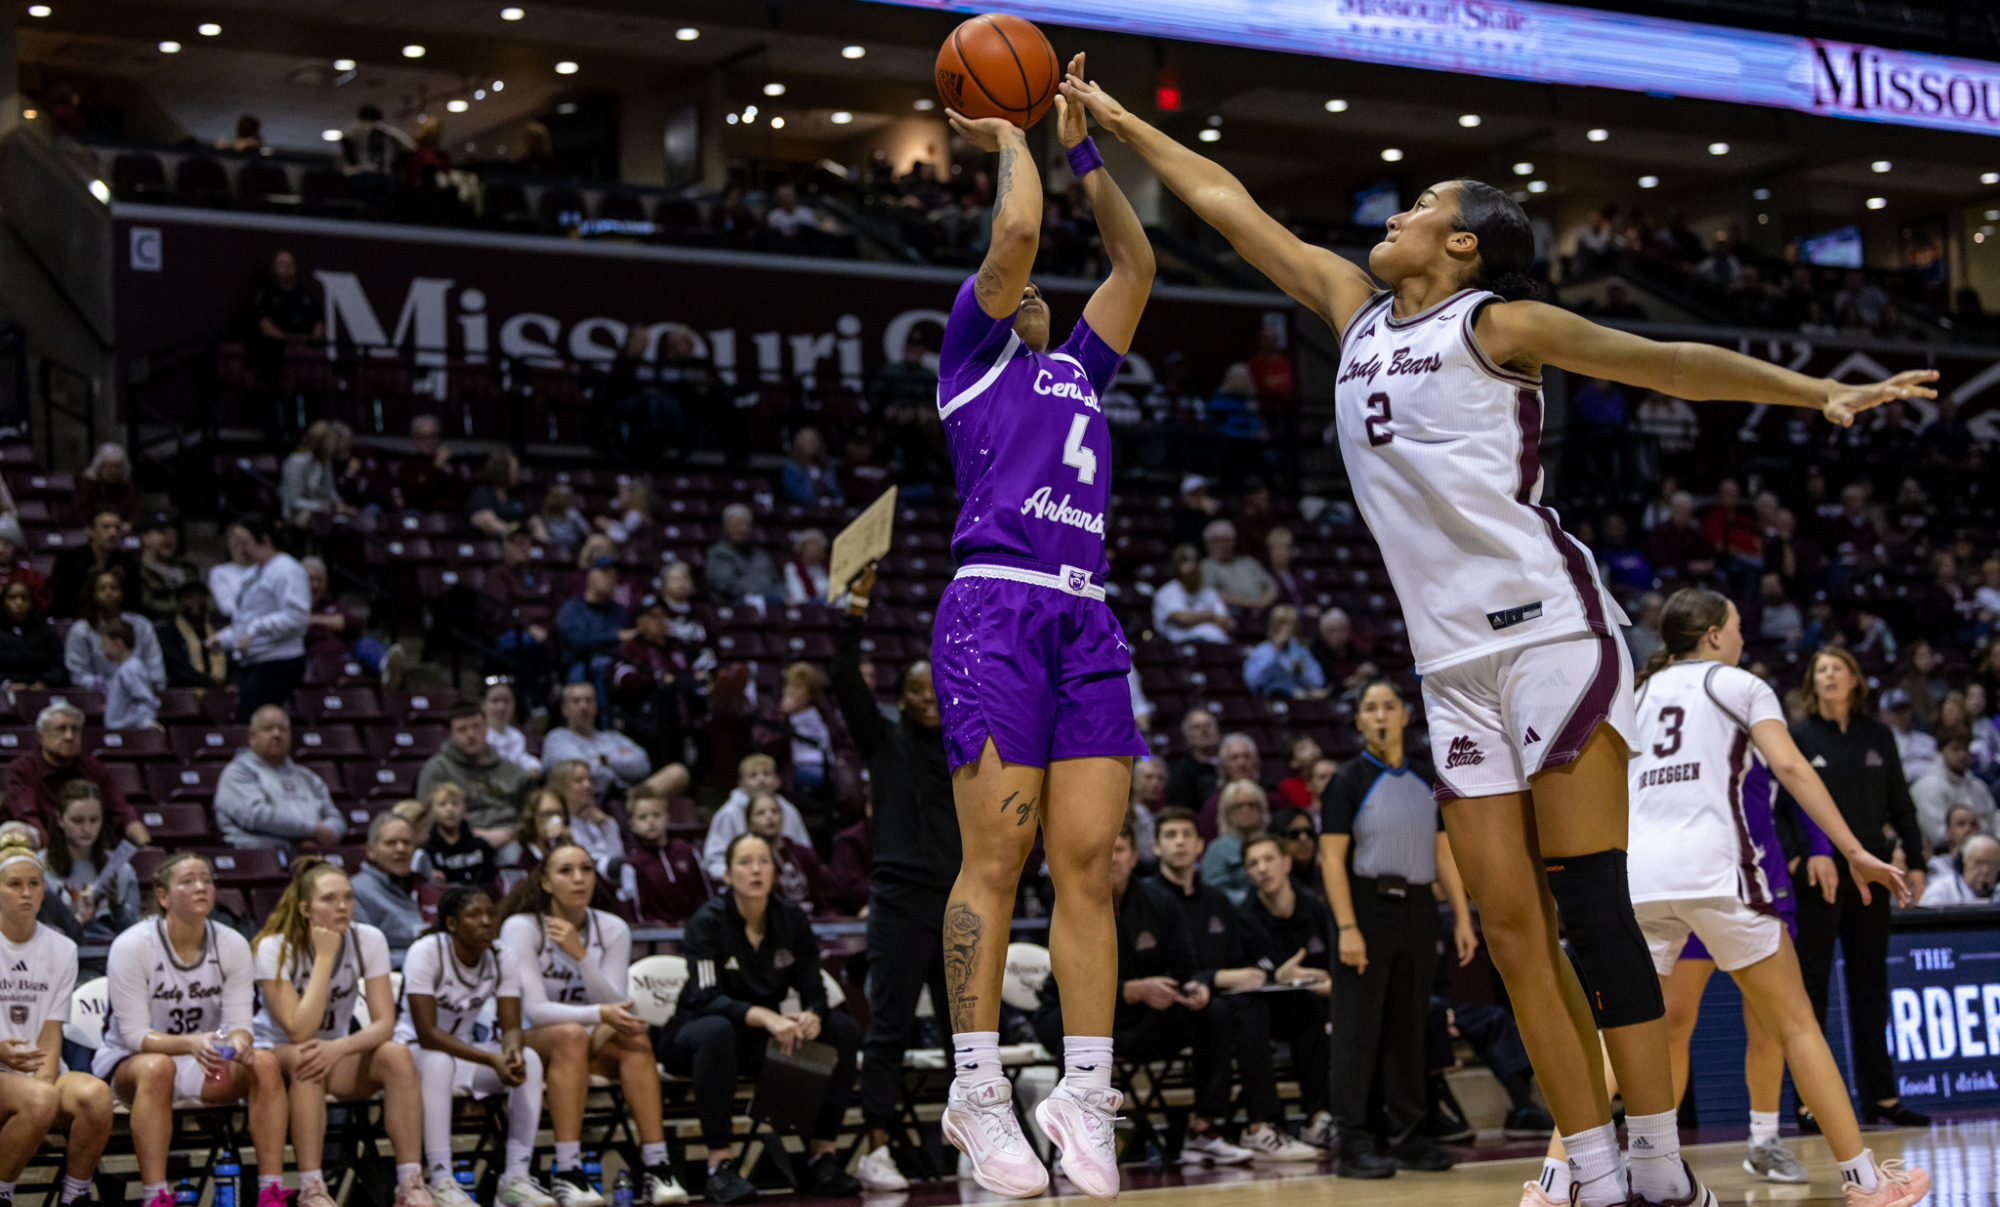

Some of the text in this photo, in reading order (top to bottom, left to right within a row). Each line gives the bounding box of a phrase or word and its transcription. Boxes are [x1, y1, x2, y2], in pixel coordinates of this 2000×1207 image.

[136, 235, 156, 264] C
[1338, 346, 1442, 387] Lady Bears
[1365, 391, 1394, 447] 2
[1062, 412, 1097, 485] 4
[1448, 735, 1477, 755] Mo
[1653, 706, 1685, 758] 3
[1445, 749, 1485, 769] State
[1909, 947, 1955, 970] THE
[168, 1008, 203, 1035] 32
[1955, 1070, 1999, 1092] drink
